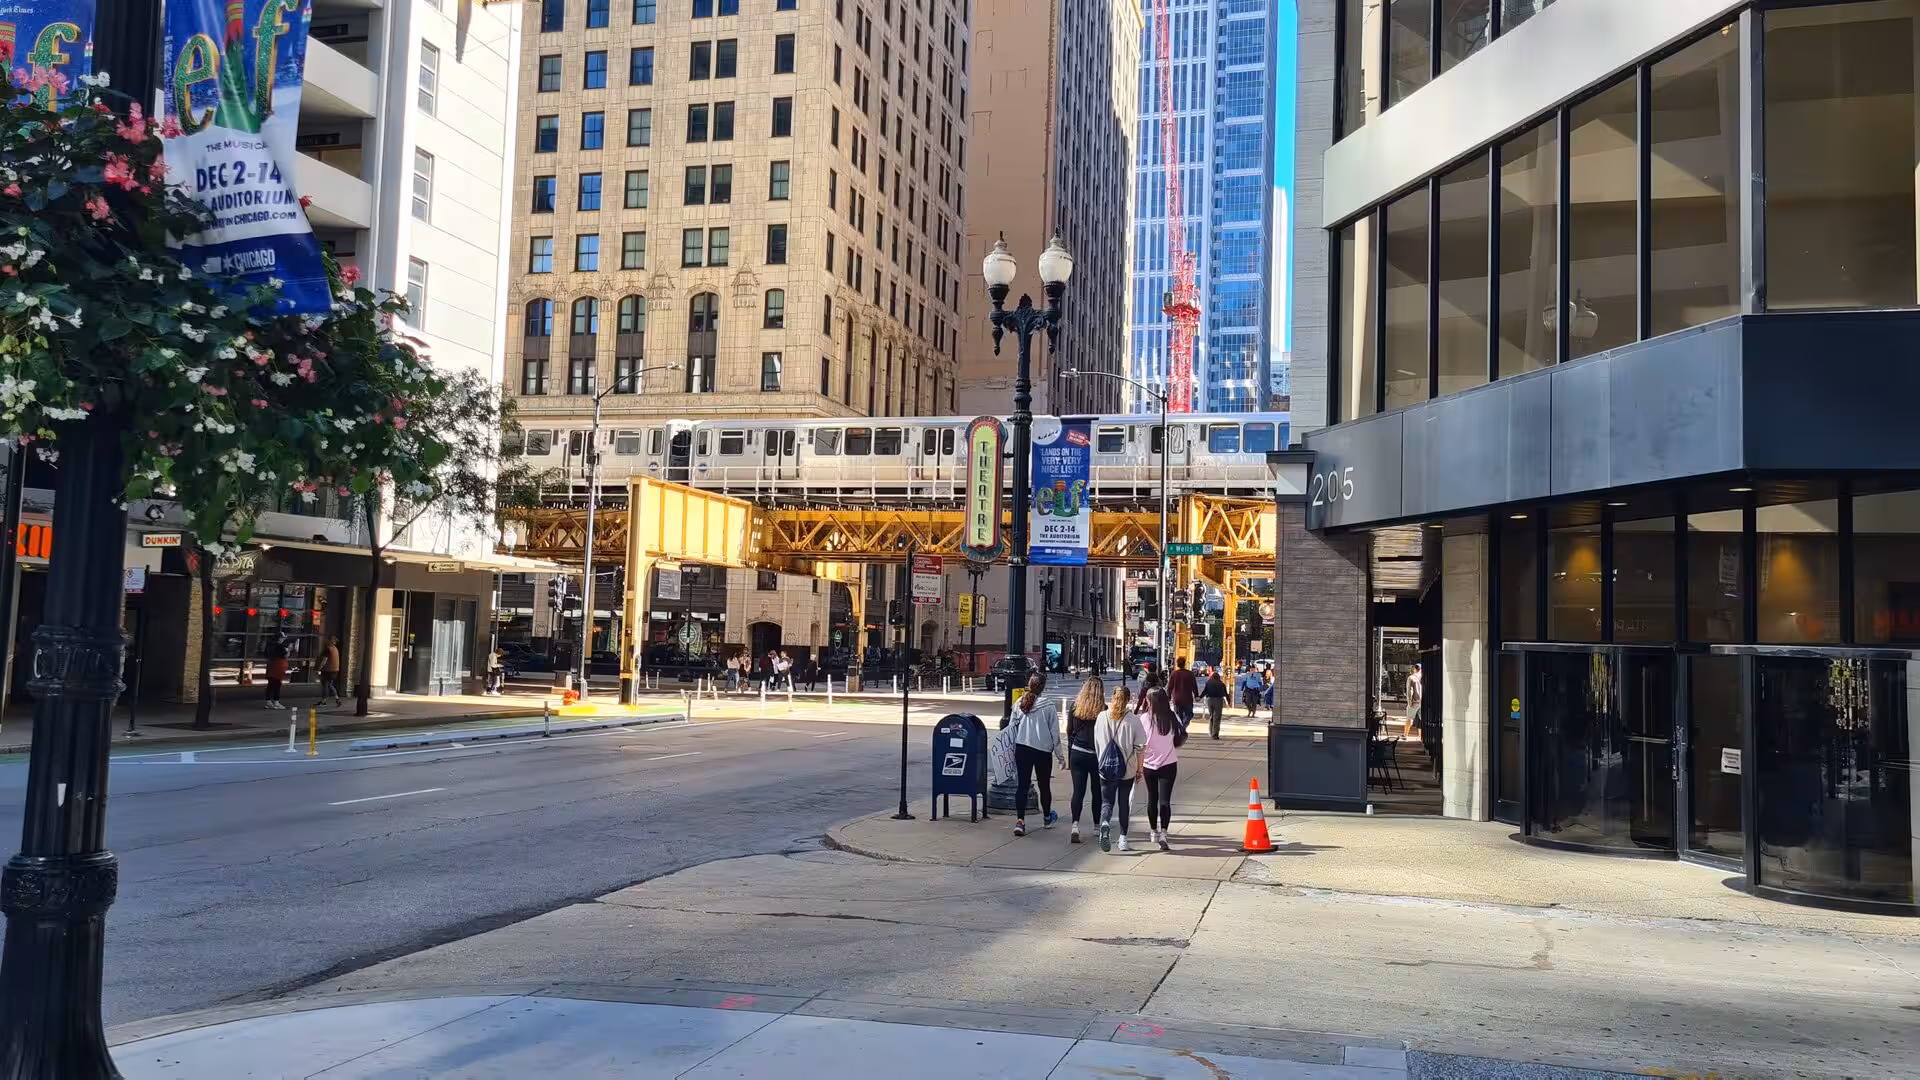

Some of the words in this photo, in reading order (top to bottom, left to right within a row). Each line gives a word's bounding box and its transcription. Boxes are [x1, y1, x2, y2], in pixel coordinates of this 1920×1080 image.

[206, 142, 221, 152] THE
[223, 140, 269, 150] MUSICA
[196, 162, 228, 192] DEC
[233, 160, 282, 185] 2-14
[233, 249, 276, 270] CHICAGO
[1061, 448, 1070, 456] ON
[1071, 448, 1082, 456] THE
[1062, 456, 1082, 465] VERY
[1041, 465, 1059, 473] NICE
[977, 440, 989, 540] THEATRE
[1312, 466, 1354, 506] 205
[1036, 480, 1085, 517] elf
[1060, 525, 1076, 533] 2-14
[1175, 545, 1194, 553] Wells
[231, 556, 255, 569] PITA
